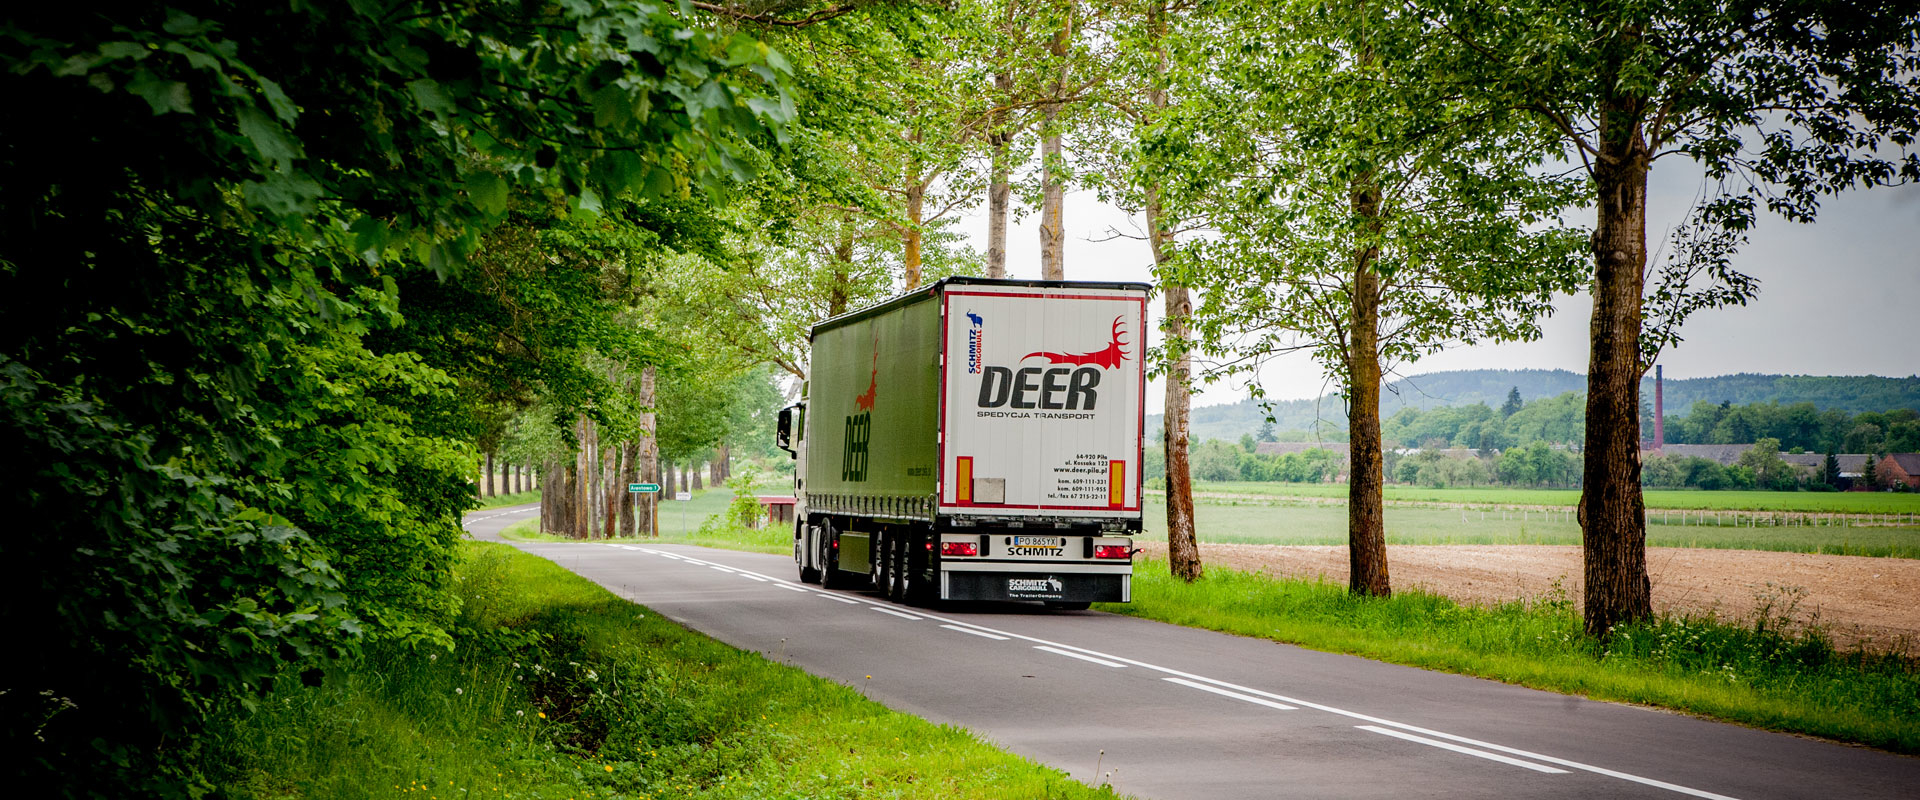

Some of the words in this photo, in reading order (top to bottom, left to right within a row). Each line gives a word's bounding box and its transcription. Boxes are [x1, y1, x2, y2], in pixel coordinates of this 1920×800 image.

[968, 329, 977, 374] SCHMITZ
[977, 366, 1101, 411] DEER
[977, 411, 1030, 419] SPEDYCJA
[1034, 412, 1096, 420] TRANSPORT
[842, 411, 871, 482] DEER
[1053, 467, 1108, 475] www.deer.pila.pl
[1019, 537, 1031, 545] PO
[1032, 537, 1056, 546] 865YX
[1008, 547, 1063, 557] SCHMITZ
